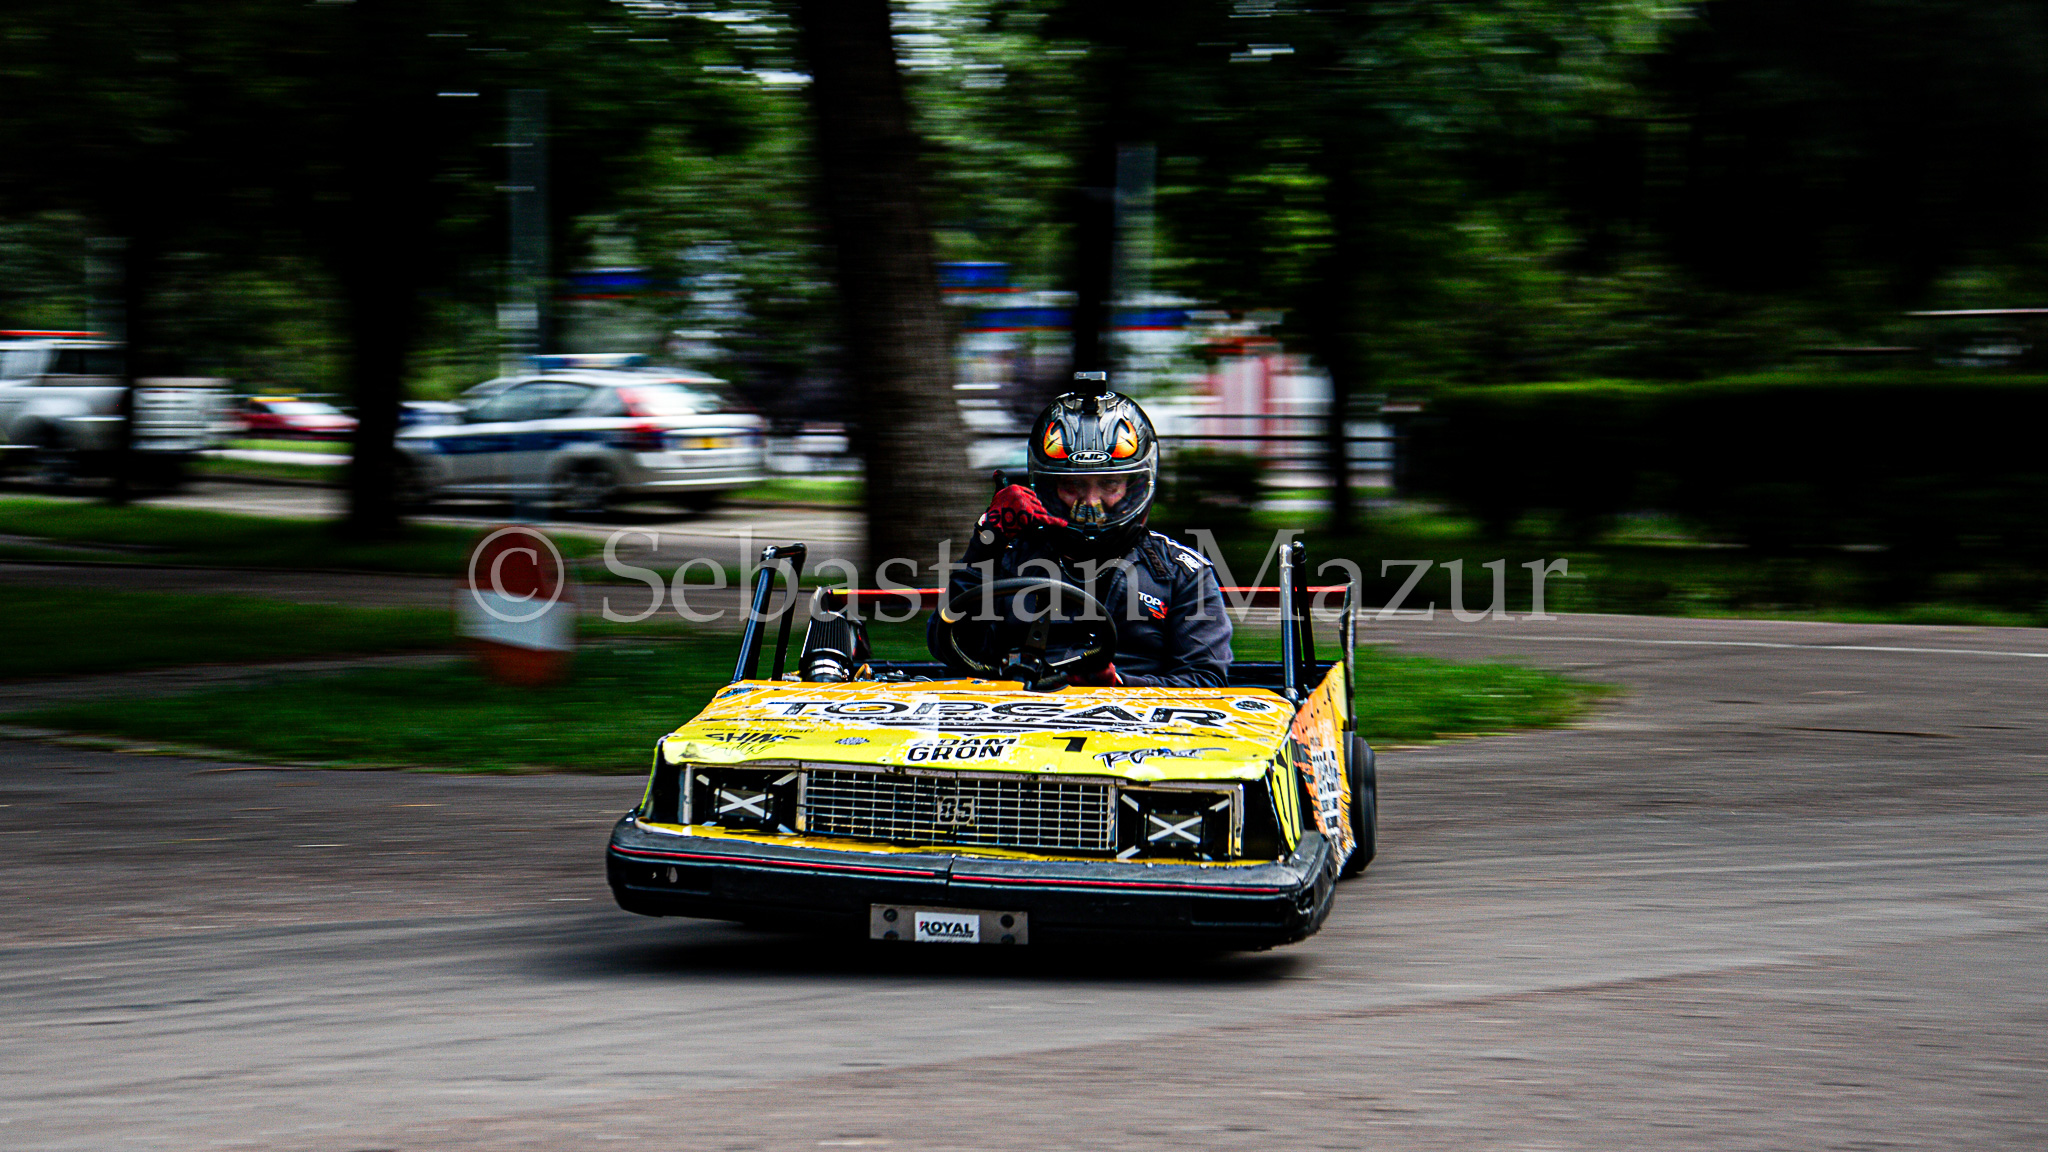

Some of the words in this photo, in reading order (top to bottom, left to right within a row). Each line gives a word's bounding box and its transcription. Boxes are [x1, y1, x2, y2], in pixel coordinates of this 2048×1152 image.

[1075, 453, 1104, 461] HJC
[907, 745, 1004, 762] GRON
[919, 920, 975, 938] ROYAL
